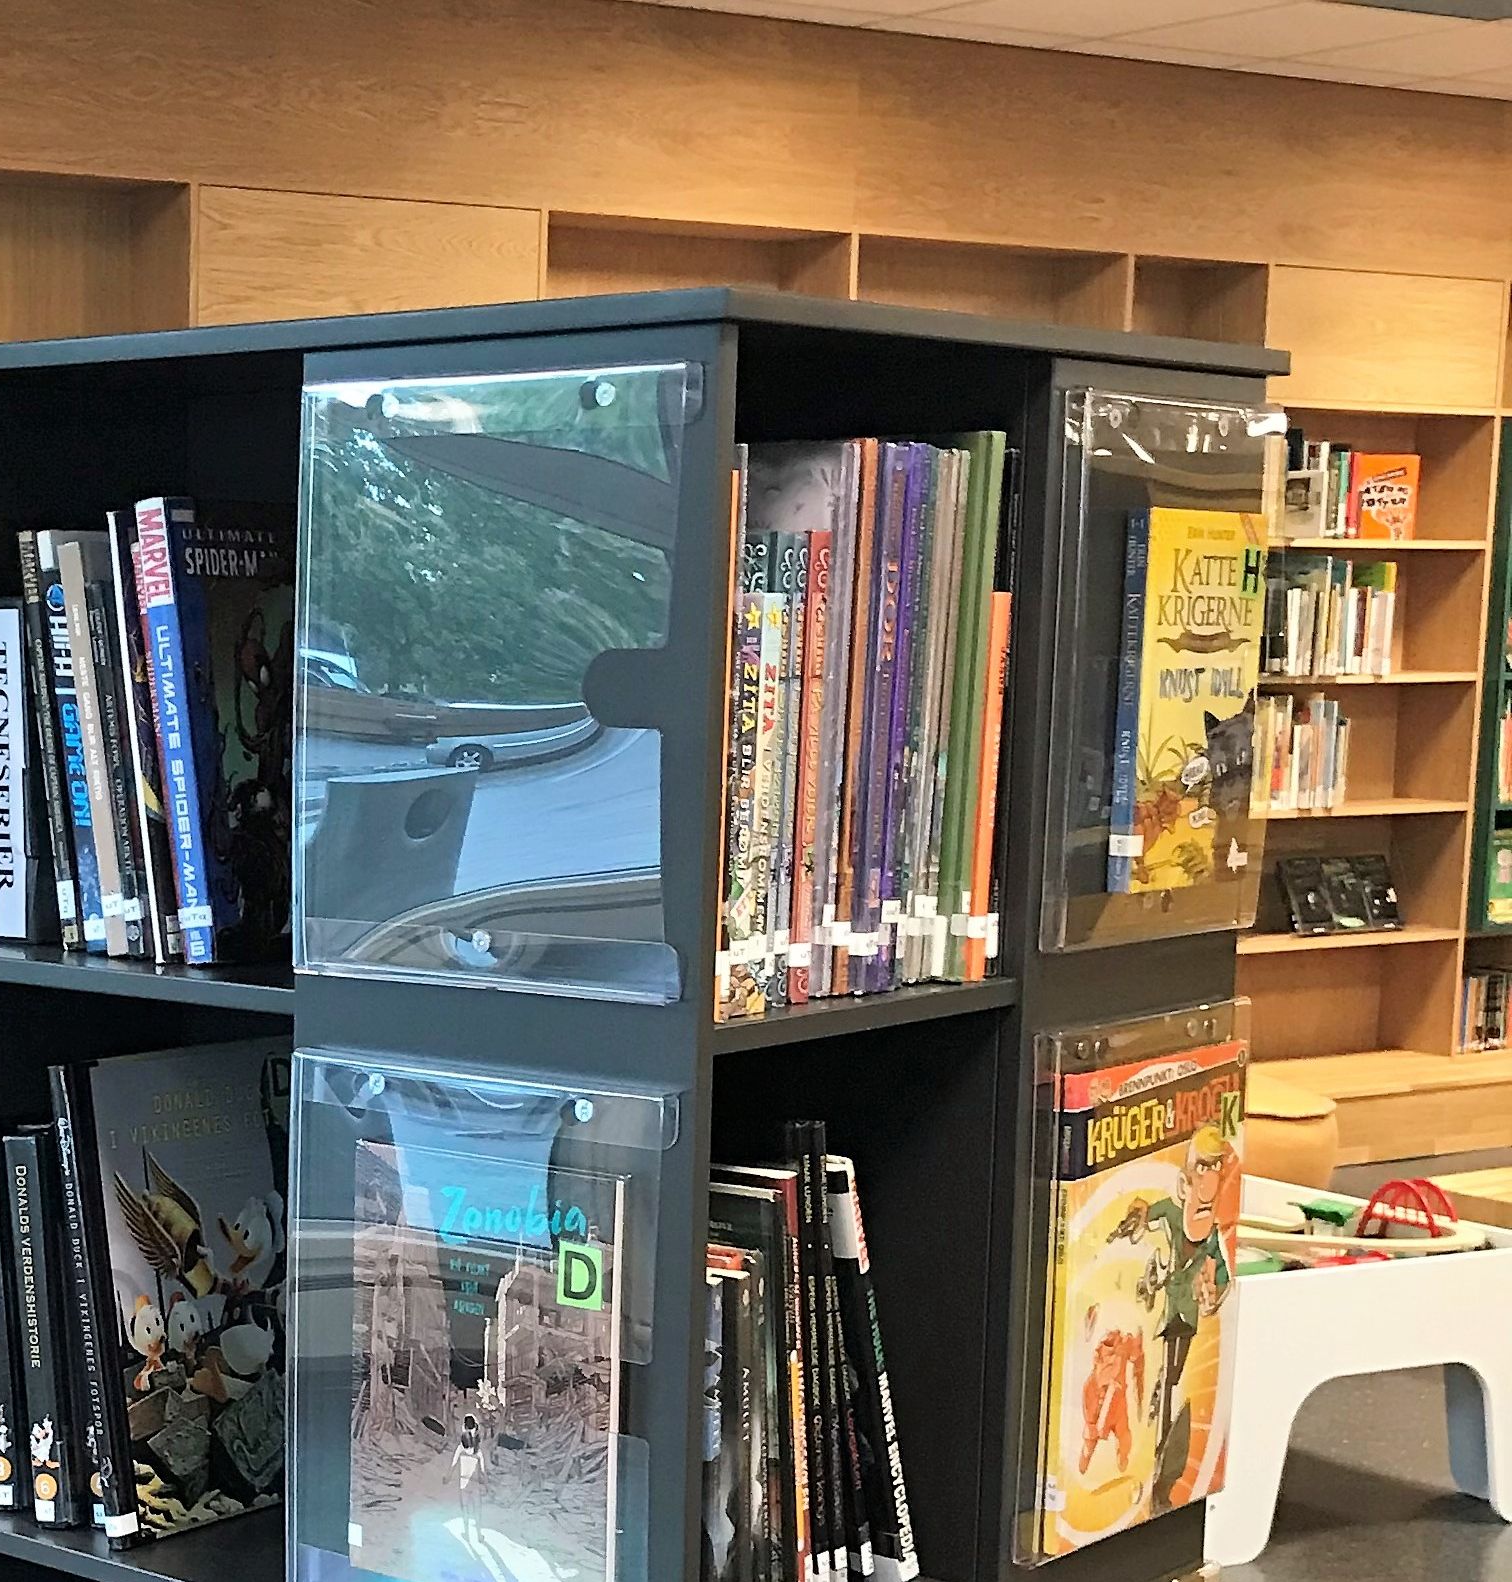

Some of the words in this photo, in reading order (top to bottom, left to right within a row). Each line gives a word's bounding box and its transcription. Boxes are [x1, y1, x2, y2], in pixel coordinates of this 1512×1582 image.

[137, 508, 171, 603] MARVEL
[182, 528, 274, 544] ULTIMATE
[185, 546, 278, 577] SPIDER-M
[1170, 548, 1238, 594] KATTE
[1243, 548, 1261, 594] H
[1157, 595, 1253, 635] KRIGERNE
[156, 624, 181, 750] ULTIMATE
[741, 662, 757, 734] ZITA
[763, 662, 777, 735] ZITA
[1159, 668, 1206, 702] KNUST
[1211, 667, 1244, 699] IDYLL
[61, 703, 85, 774] GAME
[740, 743, 751, 789] BLIR
[71, 775, 91, 827] ON!
[1087, 1098, 1166, 1167] KRÜGER
[1164, 1099, 1176, 1129] &
[1223, 1095, 1238, 1138] K
[14, 1165, 31, 1234] DONALDS
[440, 1184, 587, 1246] Zenobia
[20, 1238, 41, 1368] VERDENSHISTORIE
[563, 1250, 598, 1301] D
[64, 1182, 77, 1231] DONALD
[71, 1238, 83, 1269] DUCK
[78, 1293, 96, 1372] VIKINGENES
[89, 1380, 104, 1436] FOTSPOR
[877, 1371, 897, 1441] MARVEL
[889, 1442, 918, 1568] ENCYCLOPEDIA
